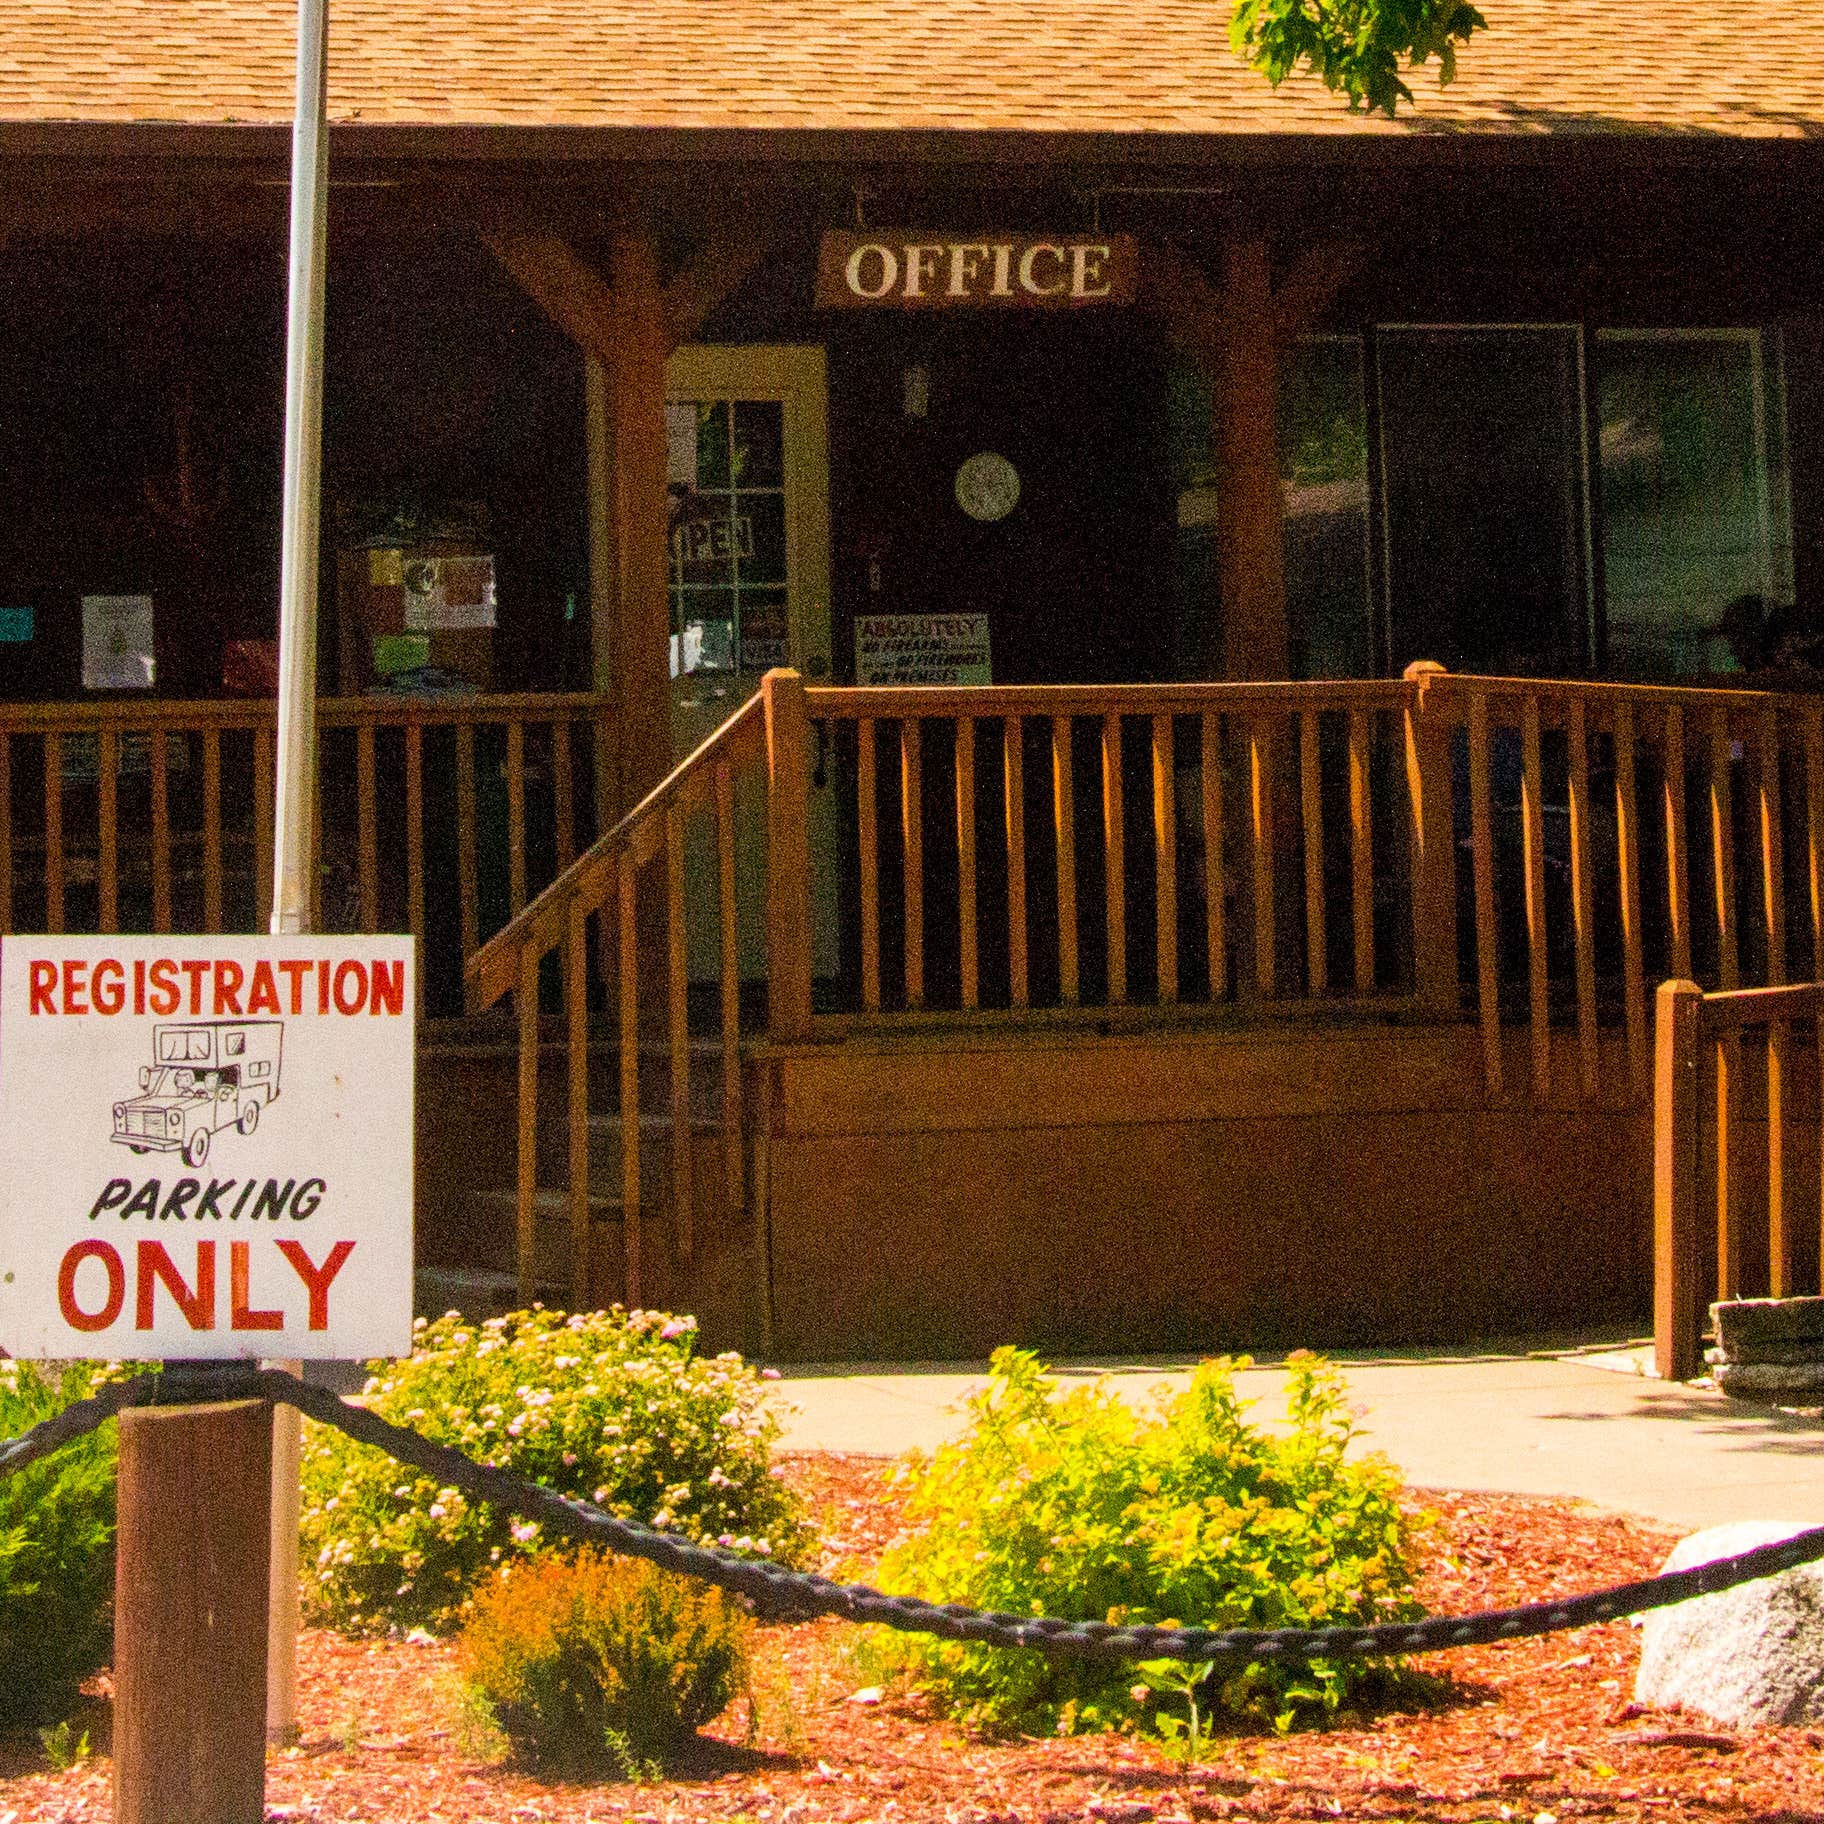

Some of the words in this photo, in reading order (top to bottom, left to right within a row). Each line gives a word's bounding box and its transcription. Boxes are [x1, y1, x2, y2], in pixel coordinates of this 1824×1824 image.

[845, 243, 1112, 299] OFFICE
[861, 618, 984, 638] ABSOLUTELY
[28, 958, 405, 1016] REGISTRATION
[88, 1176, 327, 1222] PARKING
[56, 1238, 357, 1333] ONLY
